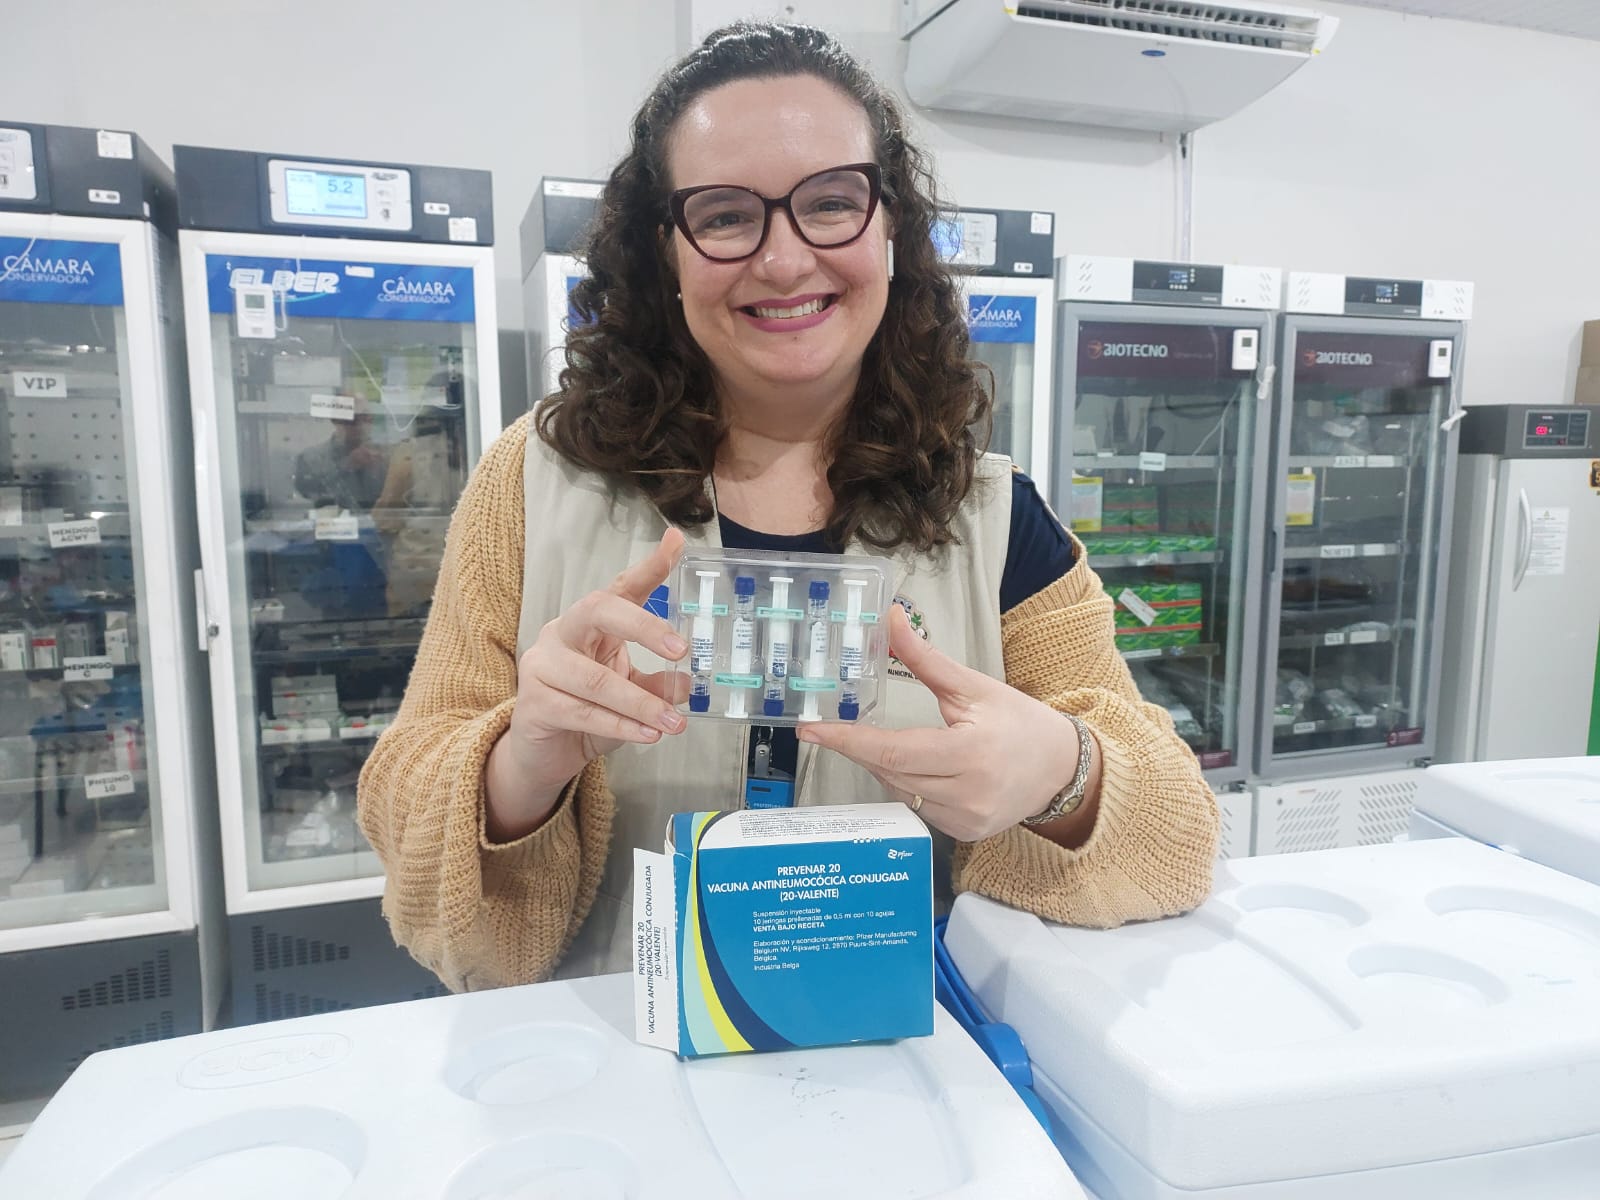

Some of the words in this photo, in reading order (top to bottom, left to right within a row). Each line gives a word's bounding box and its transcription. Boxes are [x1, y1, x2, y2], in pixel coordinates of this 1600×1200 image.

[4, 252, 95, 276] CÂMARA
[1, 271, 89, 285] ONSERVADORA
[382, 276, 455, 297] CÂMARA
[377, 293, 451, 304] CONSERVADORA
[1103, 343, 1168, 358] BIOTECNO
[23, 376, 57, 391] VIP
[777, 864, 826, 876] PREVENAR
[828, 863, 841, 873] 20
[707, 882, 750, 893] VACUNA
[751, 875, 847, 890] ANTINEUMOCÓCICA
[849, 872, 910, 884] CONJUGADA
[645, 865, 653, 917] CONJUGADA
[780, 887, 840, 903] (20-VALENTE)
[752, 909, 789, 918] Suspensión
[789, 907, 822, 916] inyectable
[637, 921, 645, 932] 20
[777, 923, 797, 931] BAJO
[797, 921, 825, 929] RECETA
[637, 934, 646, 975] PREVENAR
[753, 946, 779, 955] Belgium
[781, 962, 800, 970] Belga
[647, 1001, 655, 1034] VACUNA
